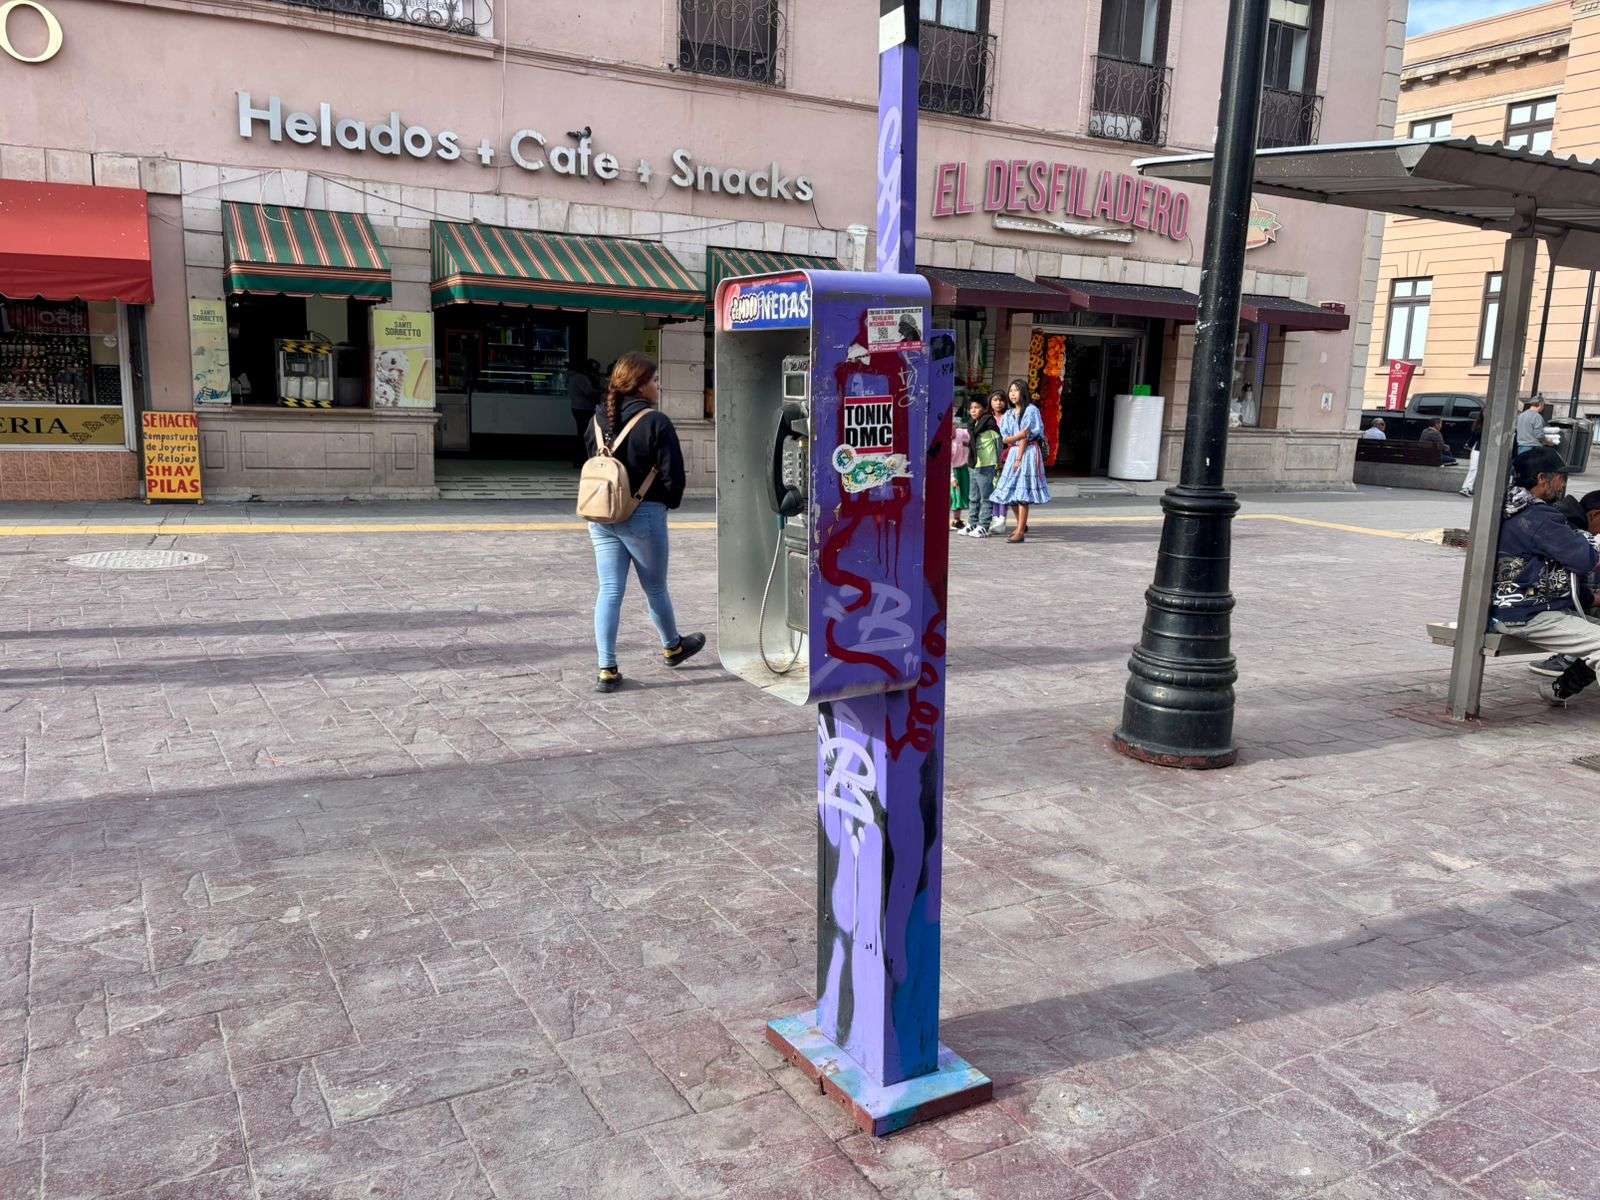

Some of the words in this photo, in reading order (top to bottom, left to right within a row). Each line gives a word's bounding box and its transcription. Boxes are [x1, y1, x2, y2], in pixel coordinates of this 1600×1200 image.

[0, 0, 63, 63] O
[238, 92, 462, 161] Helados
[671, 149, 815, 201] Snacks
[932, 160, 976, 217] EL
[984, 159, 1191, 242] DESFILADERO
[846, 404, 892, 426] TONIK
[845, 426, 892, 448] DMC
[147, 479, 200, 493] PILAS
